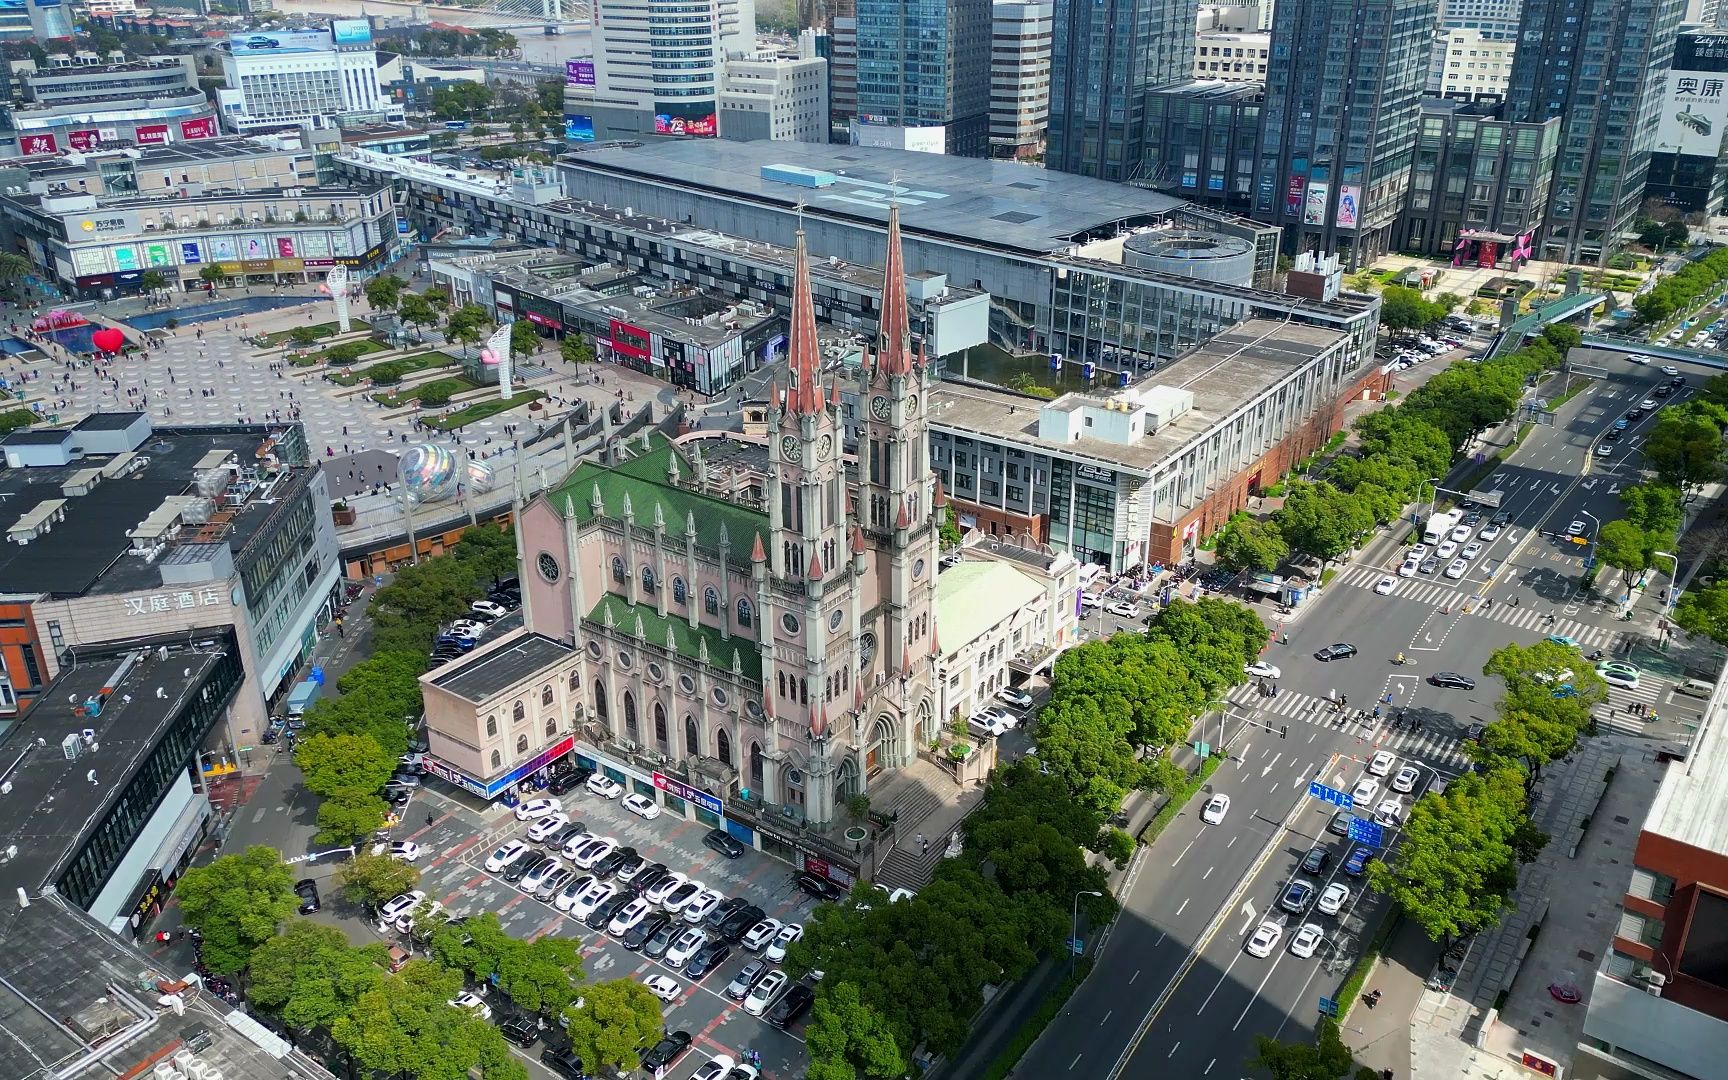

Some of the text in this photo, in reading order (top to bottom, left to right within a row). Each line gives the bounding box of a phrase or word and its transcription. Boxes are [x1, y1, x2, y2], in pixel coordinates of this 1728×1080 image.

[1675, 77, 1725, 97] 奥康
[1078, 464, 1112, 477] ASUS
[124, 589, 219, 616] 汉庭酒店
